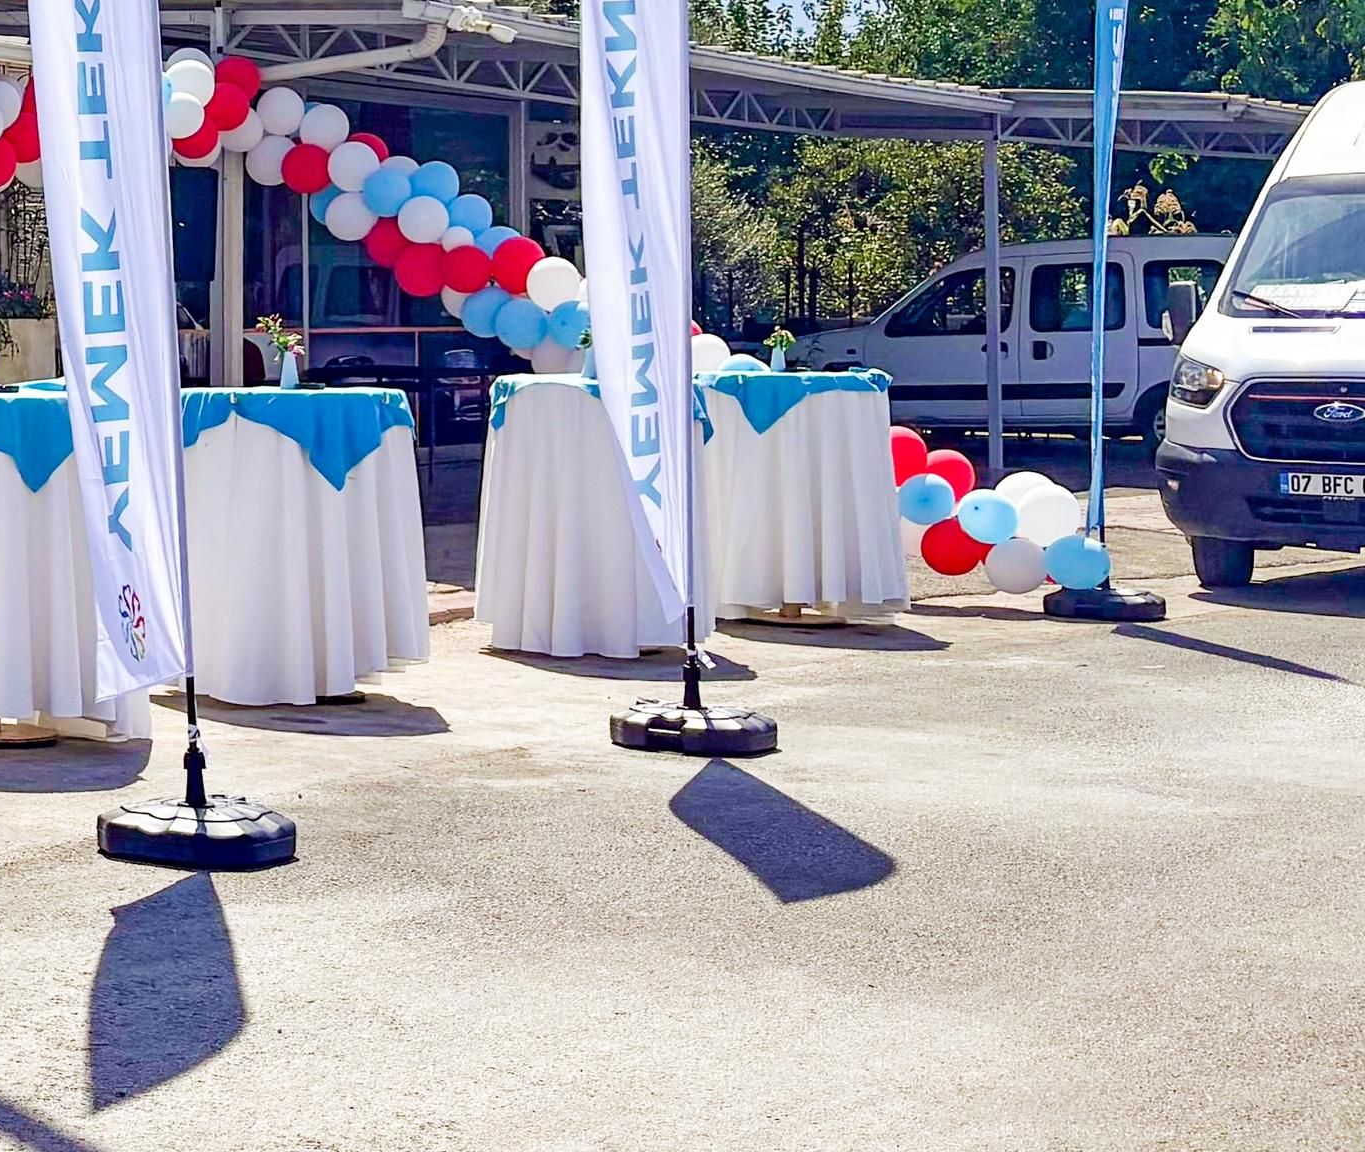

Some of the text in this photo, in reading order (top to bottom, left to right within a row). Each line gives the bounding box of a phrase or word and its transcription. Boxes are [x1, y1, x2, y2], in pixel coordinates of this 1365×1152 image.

[1323, 405, 1354, 419] Ford
[1290, 474, 1312, 493] 07
[1322, 475, 1354, 495] BFC
